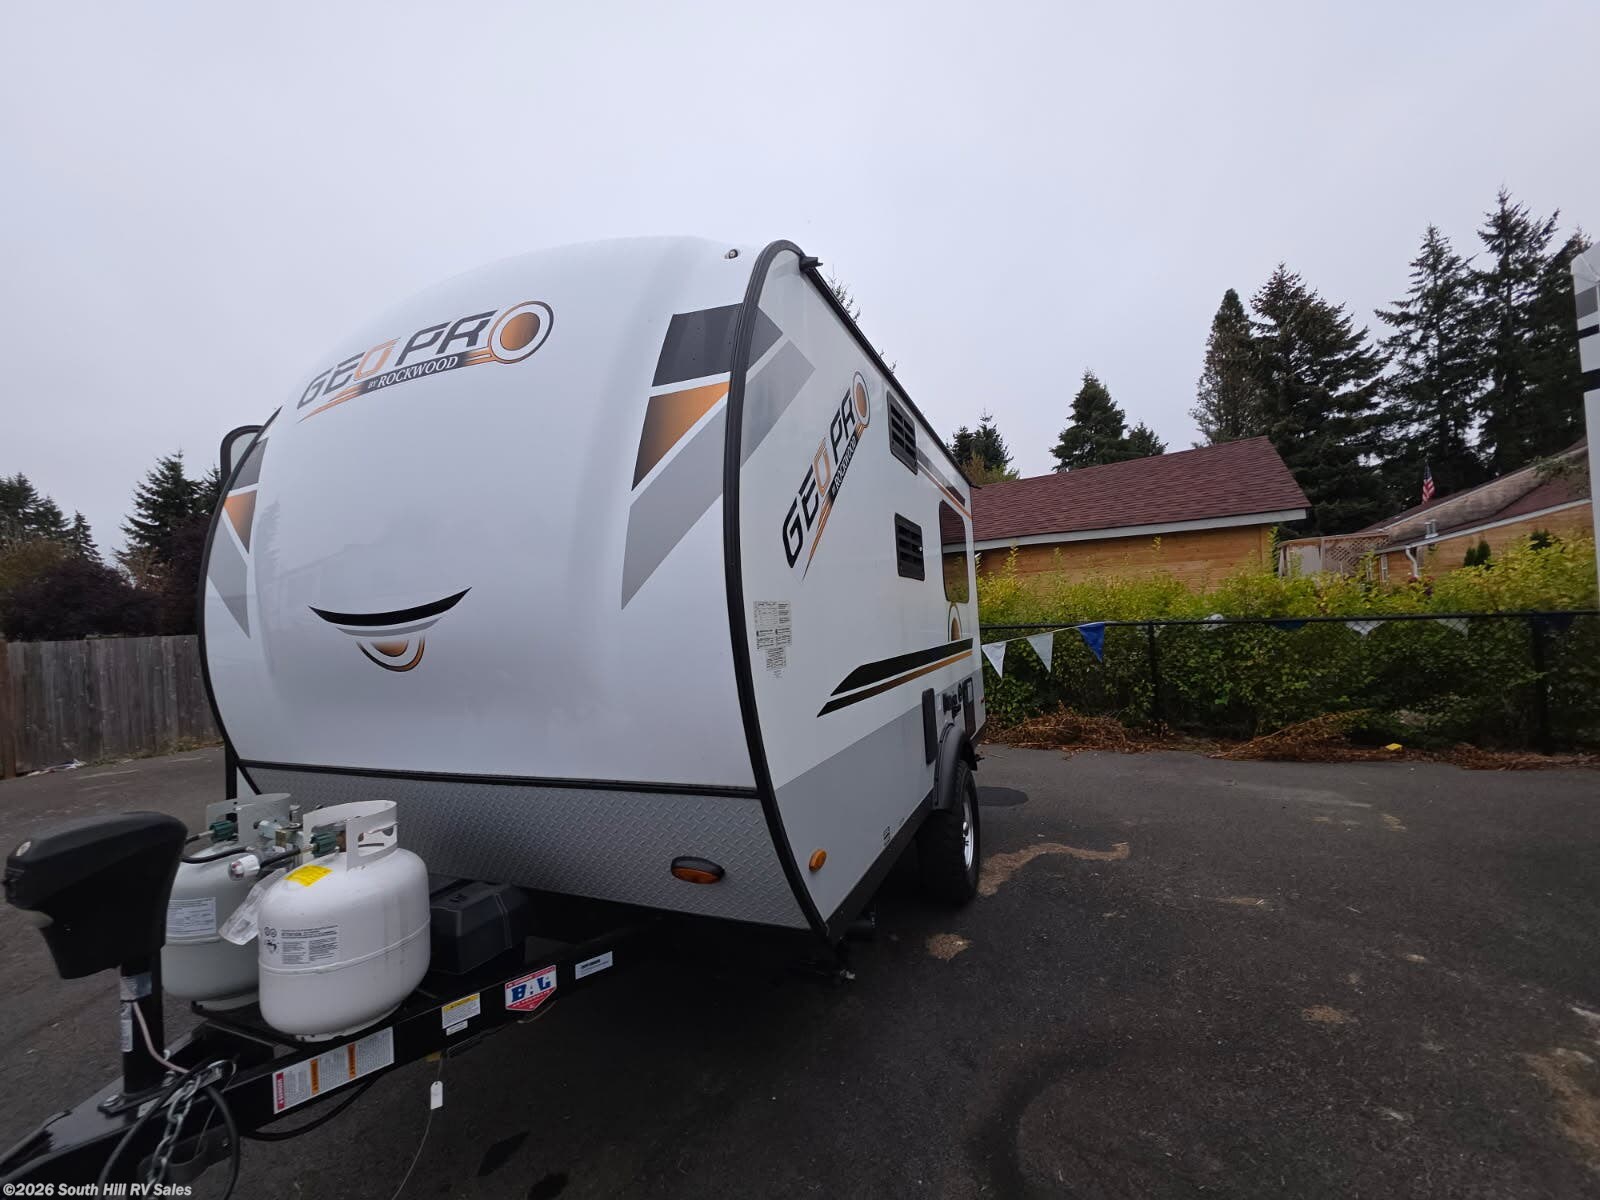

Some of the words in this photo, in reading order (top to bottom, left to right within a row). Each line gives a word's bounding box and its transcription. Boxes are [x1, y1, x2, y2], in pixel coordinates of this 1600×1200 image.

[297, 337, 400, 410] GEO
[395, 300, 554, 366] PRO
[368, 380, 379, 389] BY
[378, 355, 458, 387] ROCKWOOD
[782, 437, 831, 568] GEO
[830, 371, 870, 464] PRO
[511, 976, 551, 1002] BAL
